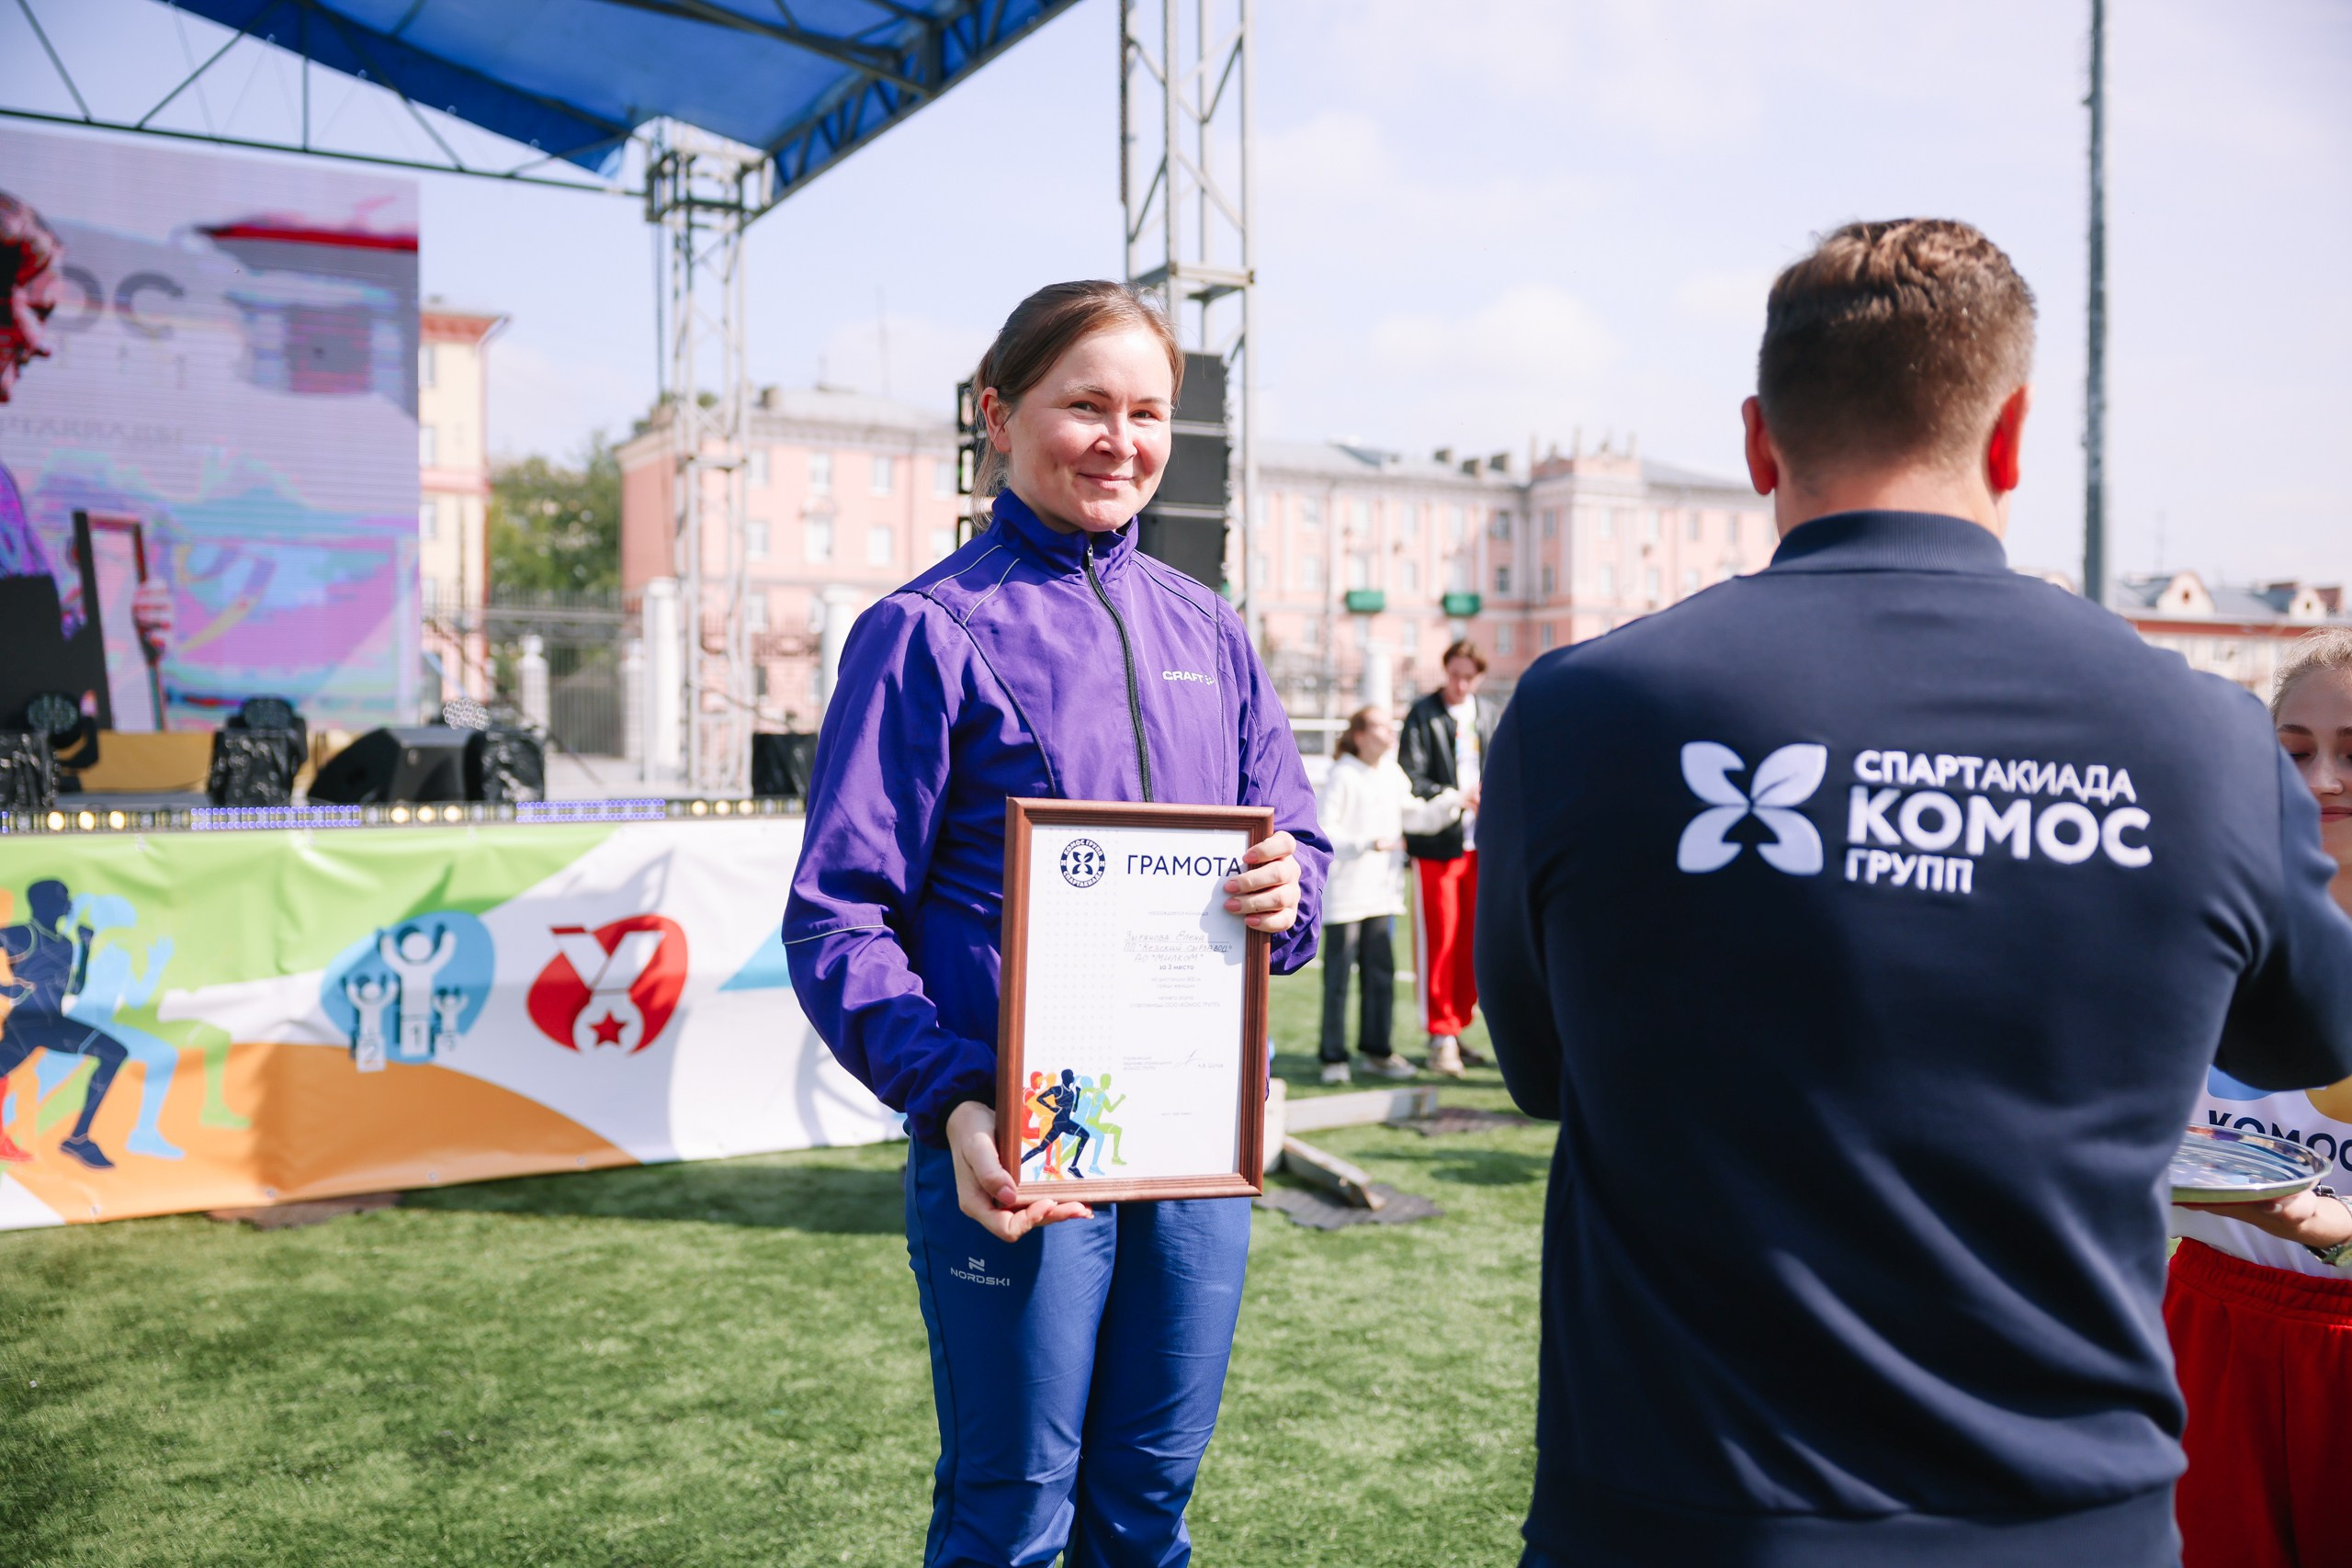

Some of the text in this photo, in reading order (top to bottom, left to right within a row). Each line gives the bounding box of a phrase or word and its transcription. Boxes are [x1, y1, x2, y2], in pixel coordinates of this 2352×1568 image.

[1162, 671, 1204, 682] CRAFT
[1853, 749, 2138, 806] СПАРТАКИАДА
[1847, 784, 2154, 868] КОМОС
[1127, 854, 1241, 876] ГРАМОТА
[1845, 848, 1974, 895] ГРУПП
[950, 1268, 1010, 1286] NORDSKI
